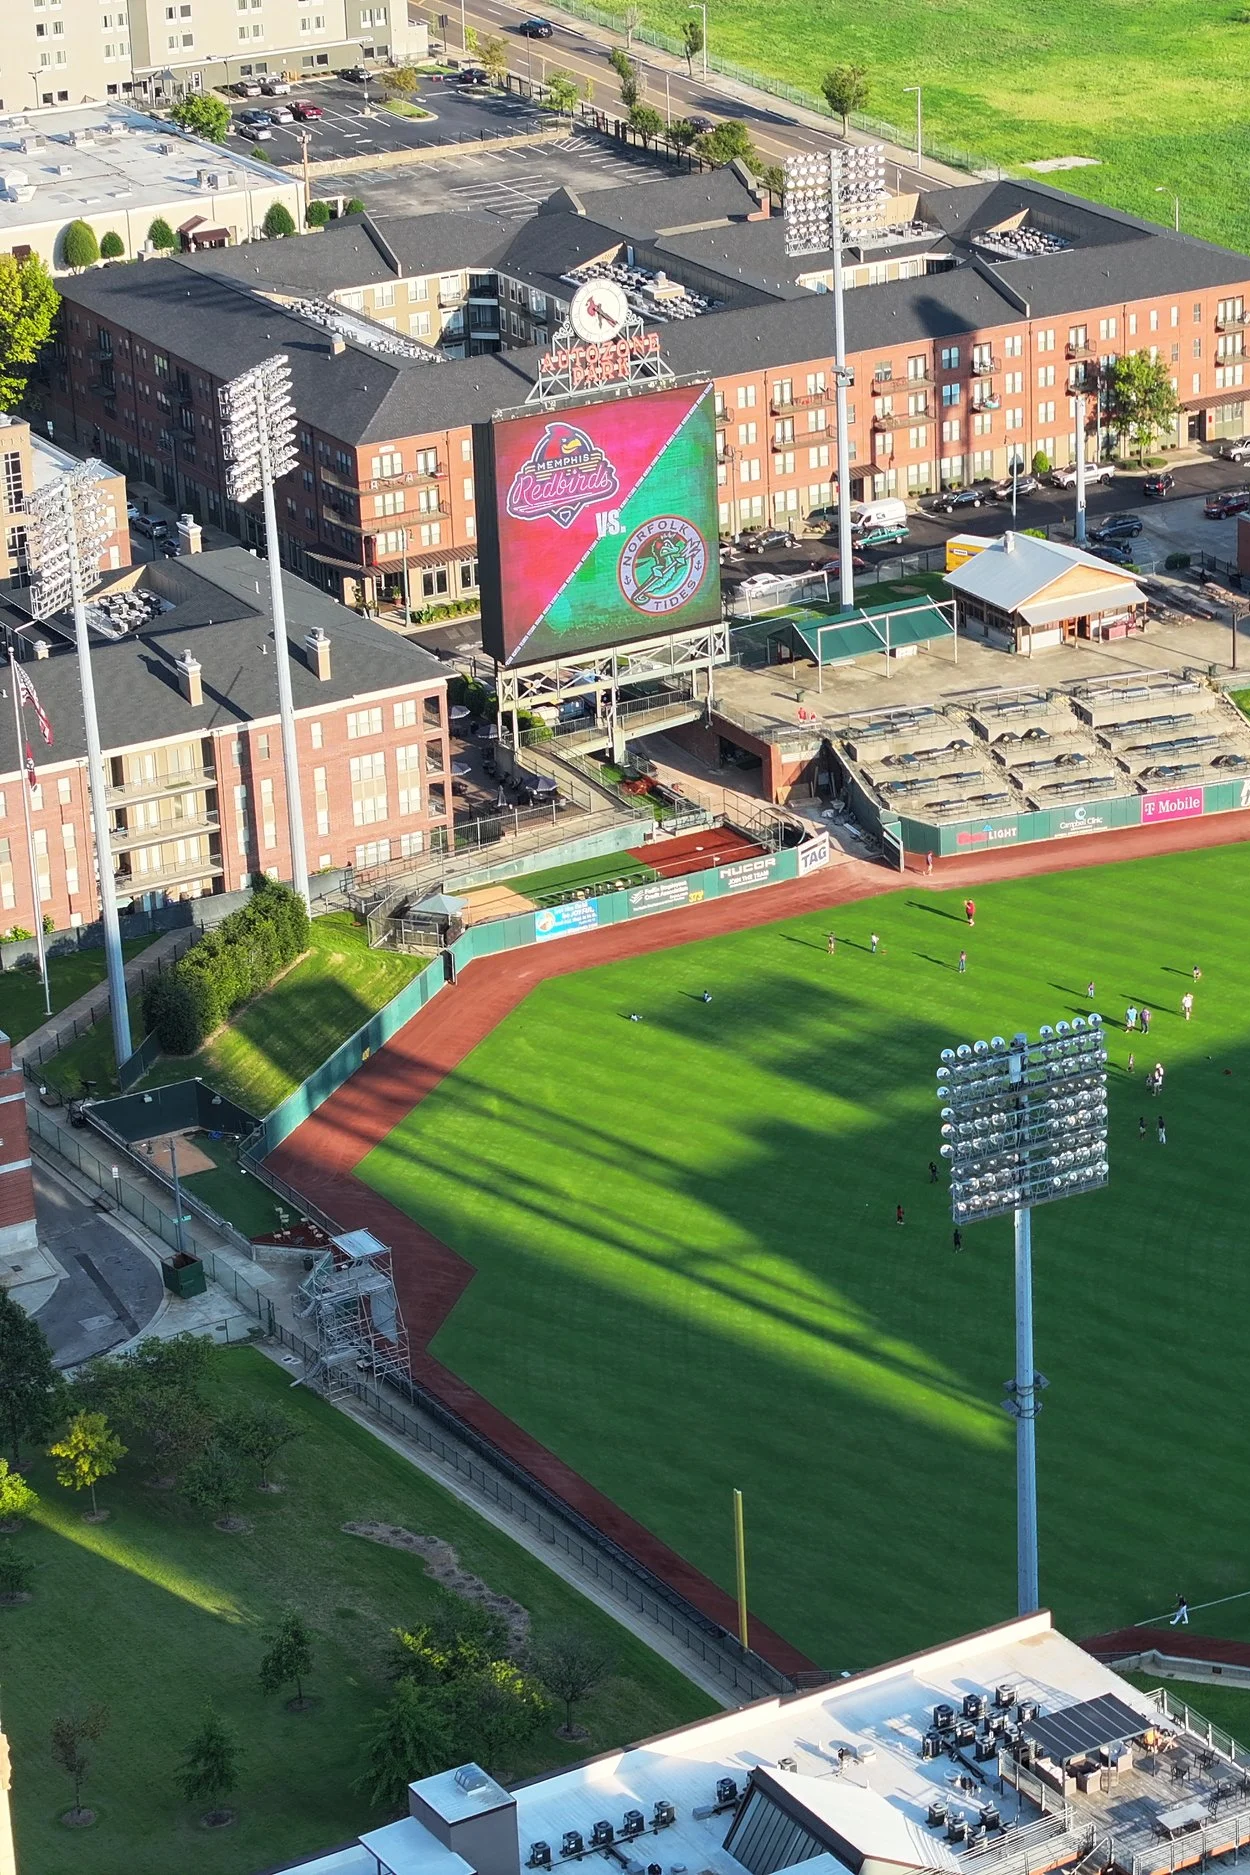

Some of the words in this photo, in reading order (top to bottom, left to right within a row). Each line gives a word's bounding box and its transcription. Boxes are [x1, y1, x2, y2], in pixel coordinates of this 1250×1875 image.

[541, 333, 660, 372] AUTOZONE
[572, 358, 630, 385] PARK
[537, 454, 590, 471] MEMPHIS
[512, 465, 612, 506] Redbirds
[623, 521, 688, 566] NORFOLK
[654, 580, 696, 610] TIDES
[1158, 796, 1200, 814] Mobile
[988, 828, 1017, 840] LIGHT
[1060, 818, 1087, 829] Campbell
[720, 857, 776, 878] NUCOR
[801, 846, 827, 868] TAG
